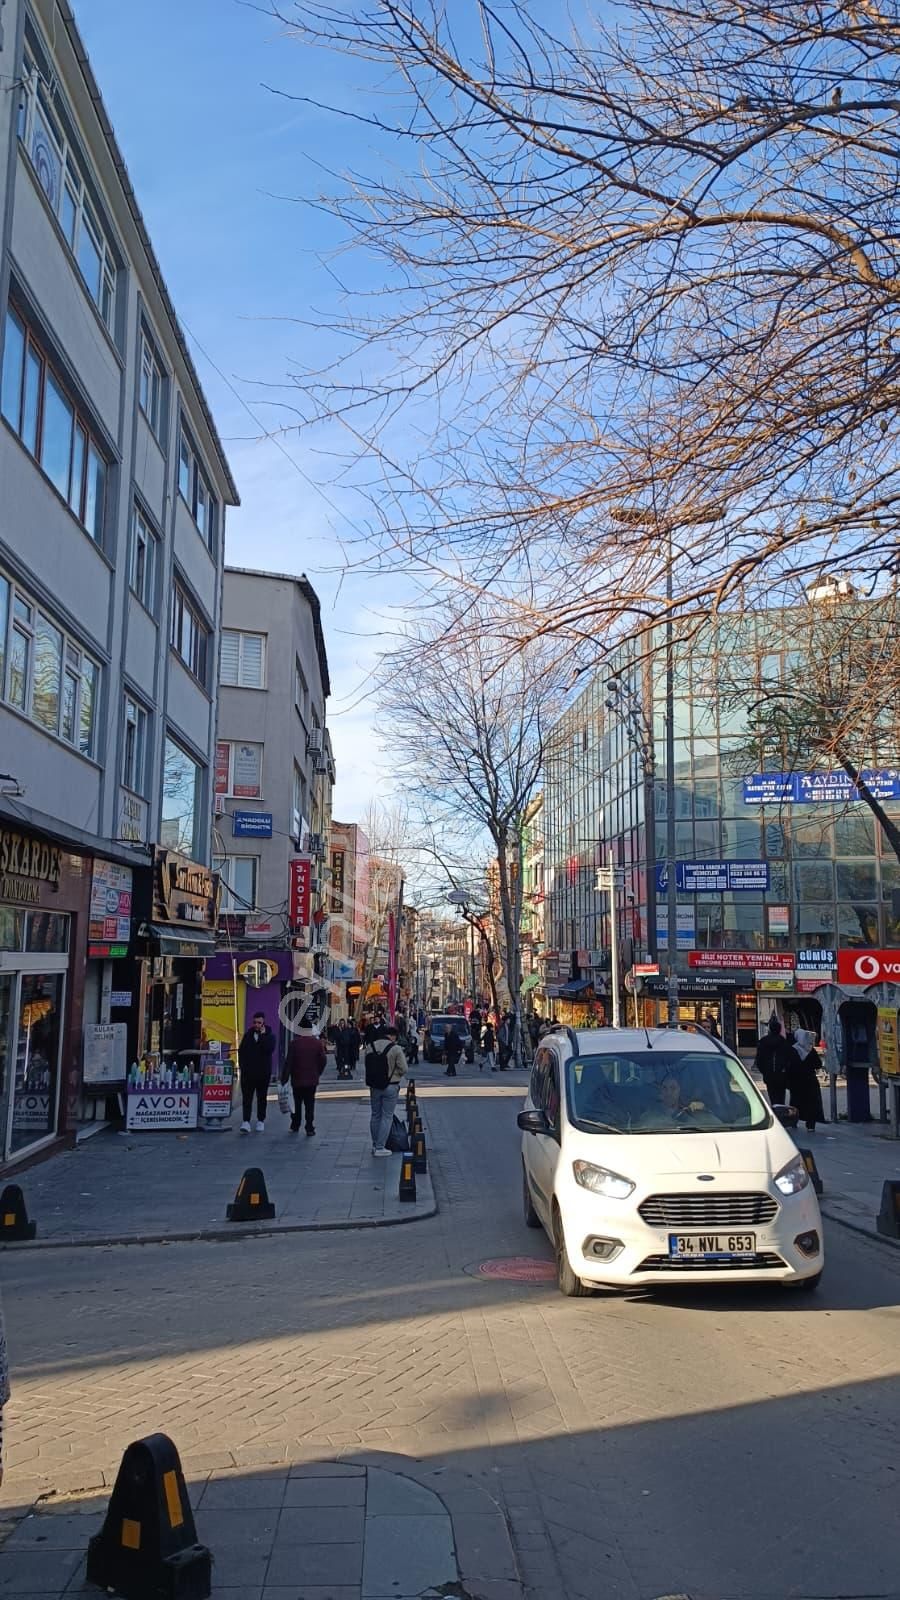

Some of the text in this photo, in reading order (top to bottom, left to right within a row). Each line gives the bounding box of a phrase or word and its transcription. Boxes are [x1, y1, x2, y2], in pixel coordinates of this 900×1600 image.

[236, 817, 271, 825] ANADOLU
[0, 830, 65, 884] ŞKARDEŞ
[296, 865, 307, 924] 3. NOTER
[717, 953, 743, 961] NOTER
[744, 953, 779, 962] YEMİNLİ
[800, 950, 833, 962] GÜMÜŞ
[136, 1096, 190, 1109] AVON
[678, 1236, 752, 1252] 34 NVL 653
